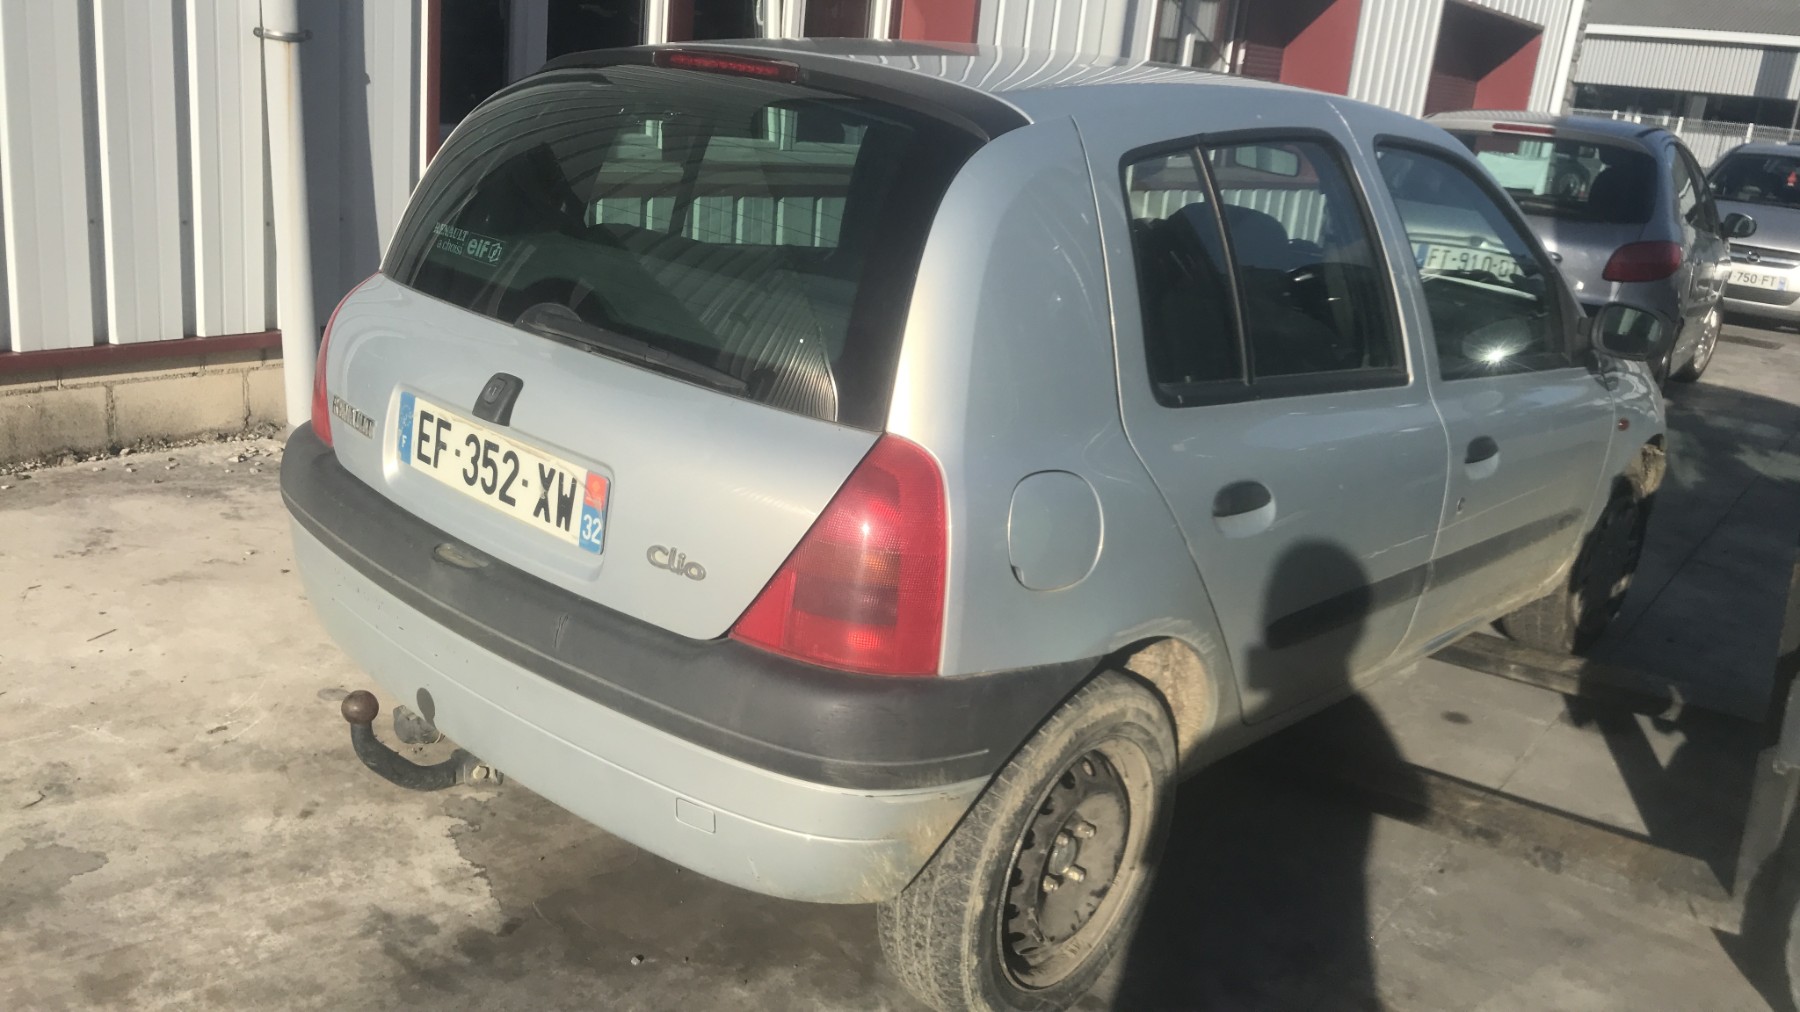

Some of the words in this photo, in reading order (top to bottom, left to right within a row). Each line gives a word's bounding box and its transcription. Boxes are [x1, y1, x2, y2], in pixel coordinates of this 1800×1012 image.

[467, 238, 491, 258] elf
[582, 514, 602, 545] 32
[646, 544, 707, 581] Clio
